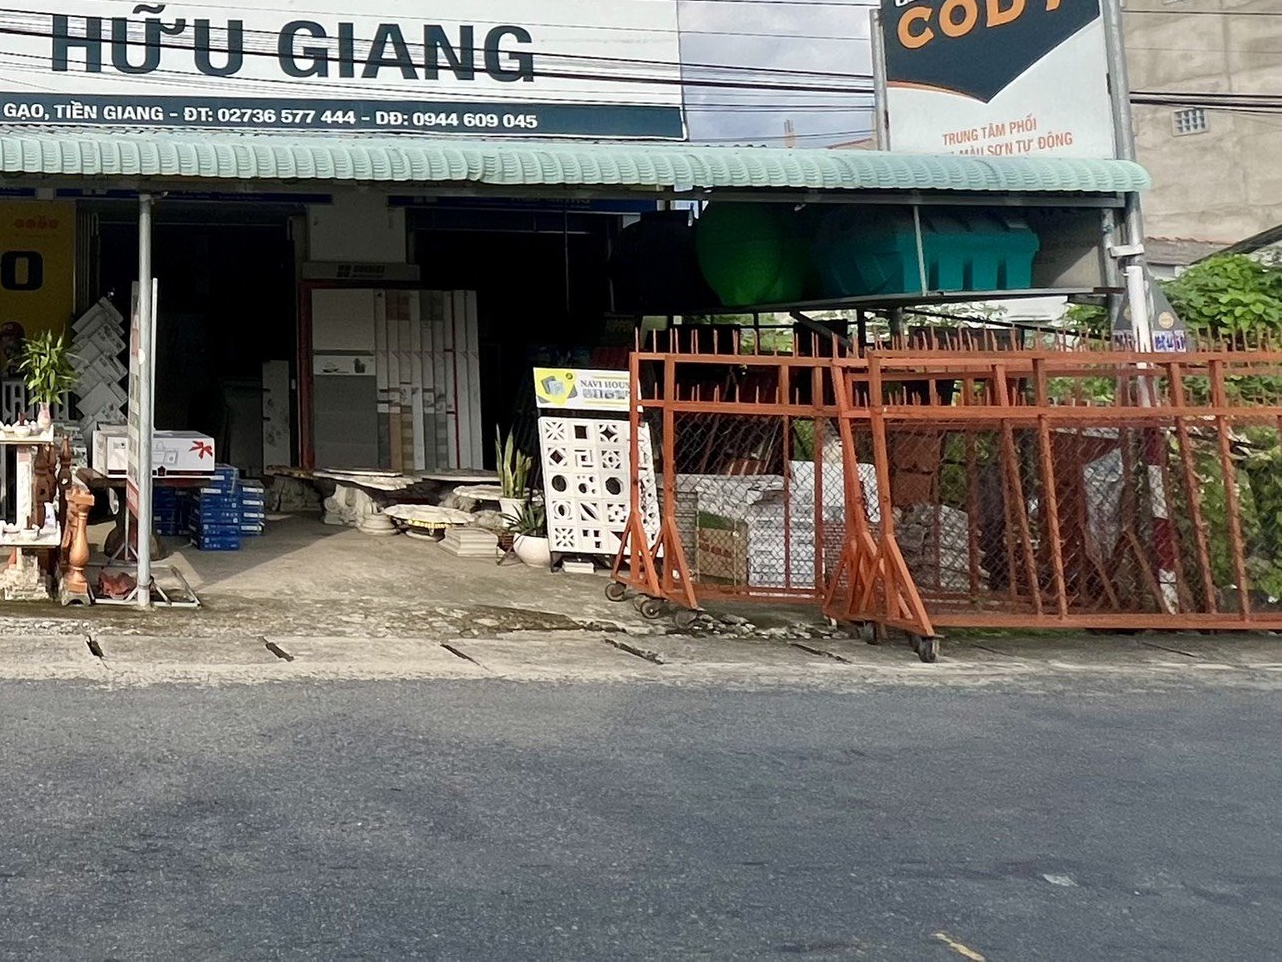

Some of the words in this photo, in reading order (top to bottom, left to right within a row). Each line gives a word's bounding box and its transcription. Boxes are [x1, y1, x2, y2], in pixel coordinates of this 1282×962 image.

[51, 4, 243, 77] HỮU
[277, 20, 535, 83] GIANG
[3, 103, 49, 121] GẠO,
[54, 100, 97, 119] TIỀN
[103, 105, 164, 121] GIANG
[183, 107, 213, 122] ĐT:
[217, 108, 276, 123] 02736
[280, 109, 316, 124] 577
[320, 110, 356, 125] 444
[375, 111, 408, 126] DĐ:
[412, 111, 459, 127] 0944
[463, 112, 499, 128] 609
[503, 113, 538, 129] 045
[942, 128, 979, 146] TRUNG
[981, 123, 1006, 140] TÂM
[1009, 113, 1037, 135] PHỐI
[1037, 131, 1073, 152] ĐỘNG
[580, 379, 602, 389] NAVI
